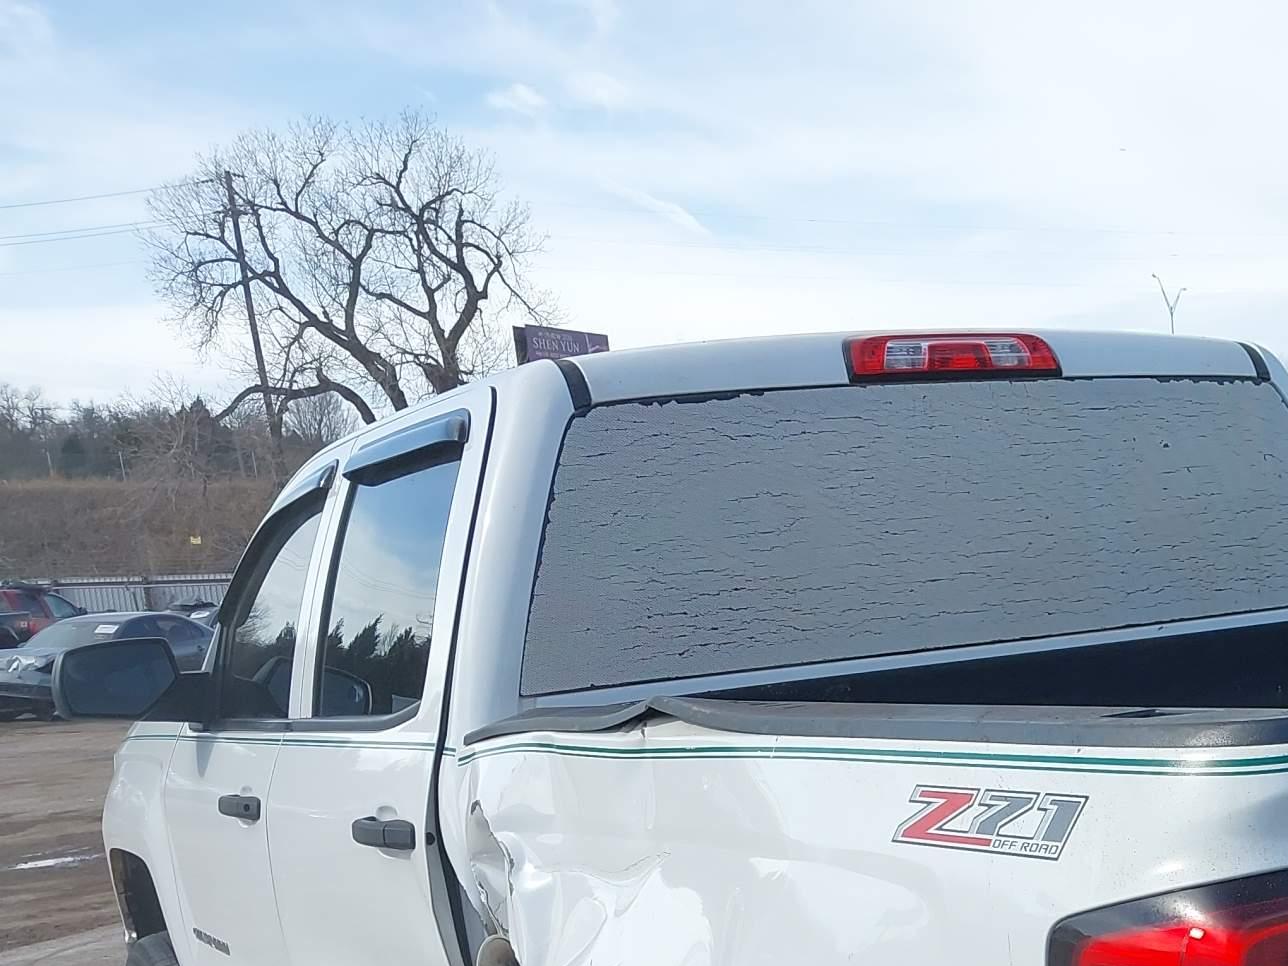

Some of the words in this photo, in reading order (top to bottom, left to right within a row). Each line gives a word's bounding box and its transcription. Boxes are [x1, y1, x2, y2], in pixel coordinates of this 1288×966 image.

[532, 337, 559, 352] SHEN
[560, 340, 580, 353] YUN
[891, 784, 1090, 855] Z71
[992, 839, 1018, 851] OFF
[1020, 841, 1059, 856] ROAD
